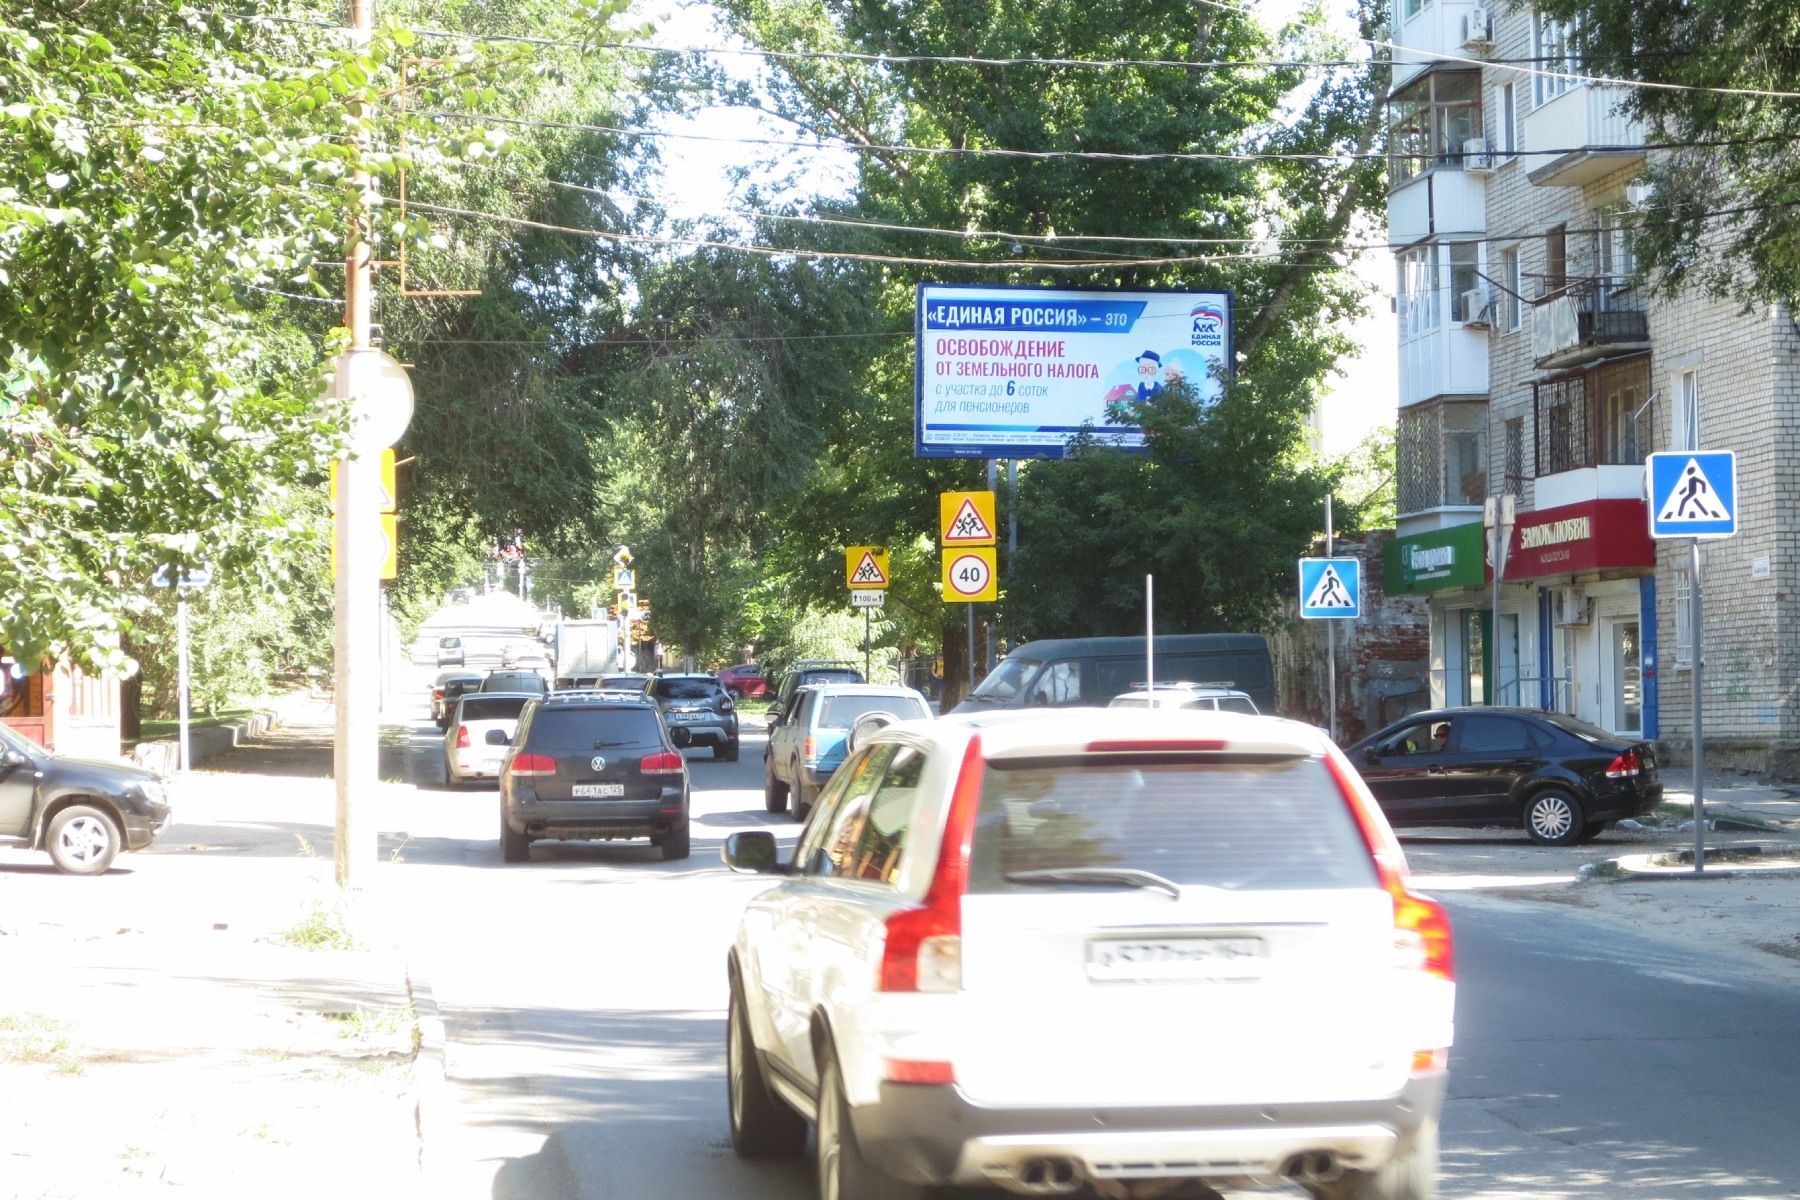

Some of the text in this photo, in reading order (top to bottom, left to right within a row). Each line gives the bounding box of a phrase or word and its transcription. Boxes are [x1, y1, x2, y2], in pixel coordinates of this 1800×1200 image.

[928, 305, 1005, 327] «ЕДИНАЯ
[1011, 307, 1087, 327] РОССИЯ»
[936, 338, 1066, 360] ОСВОБОЖДЕНИЕ
[936, 361, 1099, 379] ОТ ЗЕМЕЛЬНОГО НАЛОГА
[935, 380, 1049, 397] с участка до 6 соток
[935, 400, 1030, 416] для пенсионеров
[1520, 516, 1590, 550] ЗАМОК ЛЮБВИ
[959, 567, 980, 583] 40
